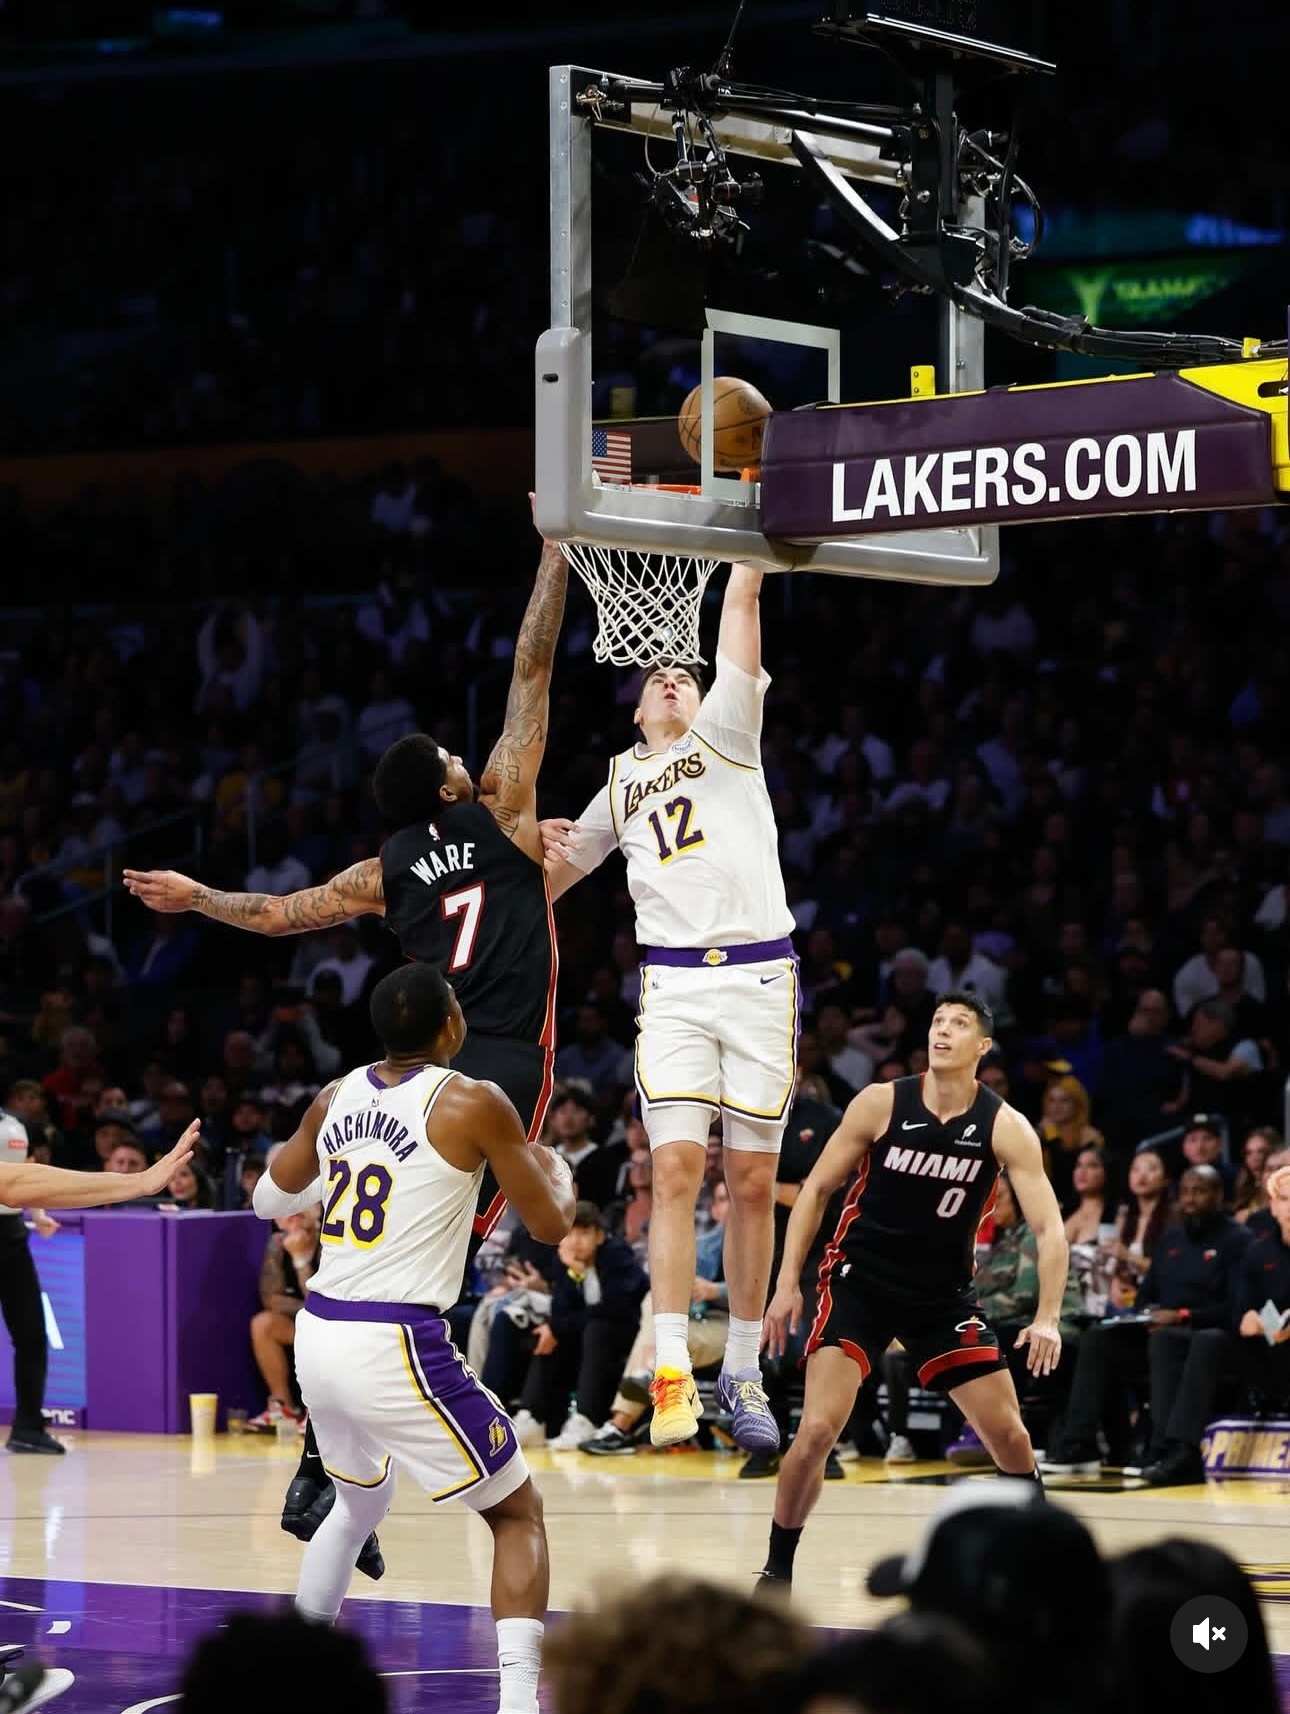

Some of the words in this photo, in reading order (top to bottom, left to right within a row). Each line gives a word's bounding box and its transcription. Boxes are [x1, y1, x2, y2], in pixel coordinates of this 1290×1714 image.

[832, 429, 1197, 523] LAKERS.COM
[623, 752, 706, 823] LAKERS
[410, 842, 475, 886] WARE
[648, 796, 705, 866] 12
[440, 881, 485, 974] 7
[323, 1110, 418, 1163] HACHIMURA
[883, 1146, 983, 1183] MIAMI
[320, 1158, 393, 1250] 28
[936, 1187, 967, 1218] 0
